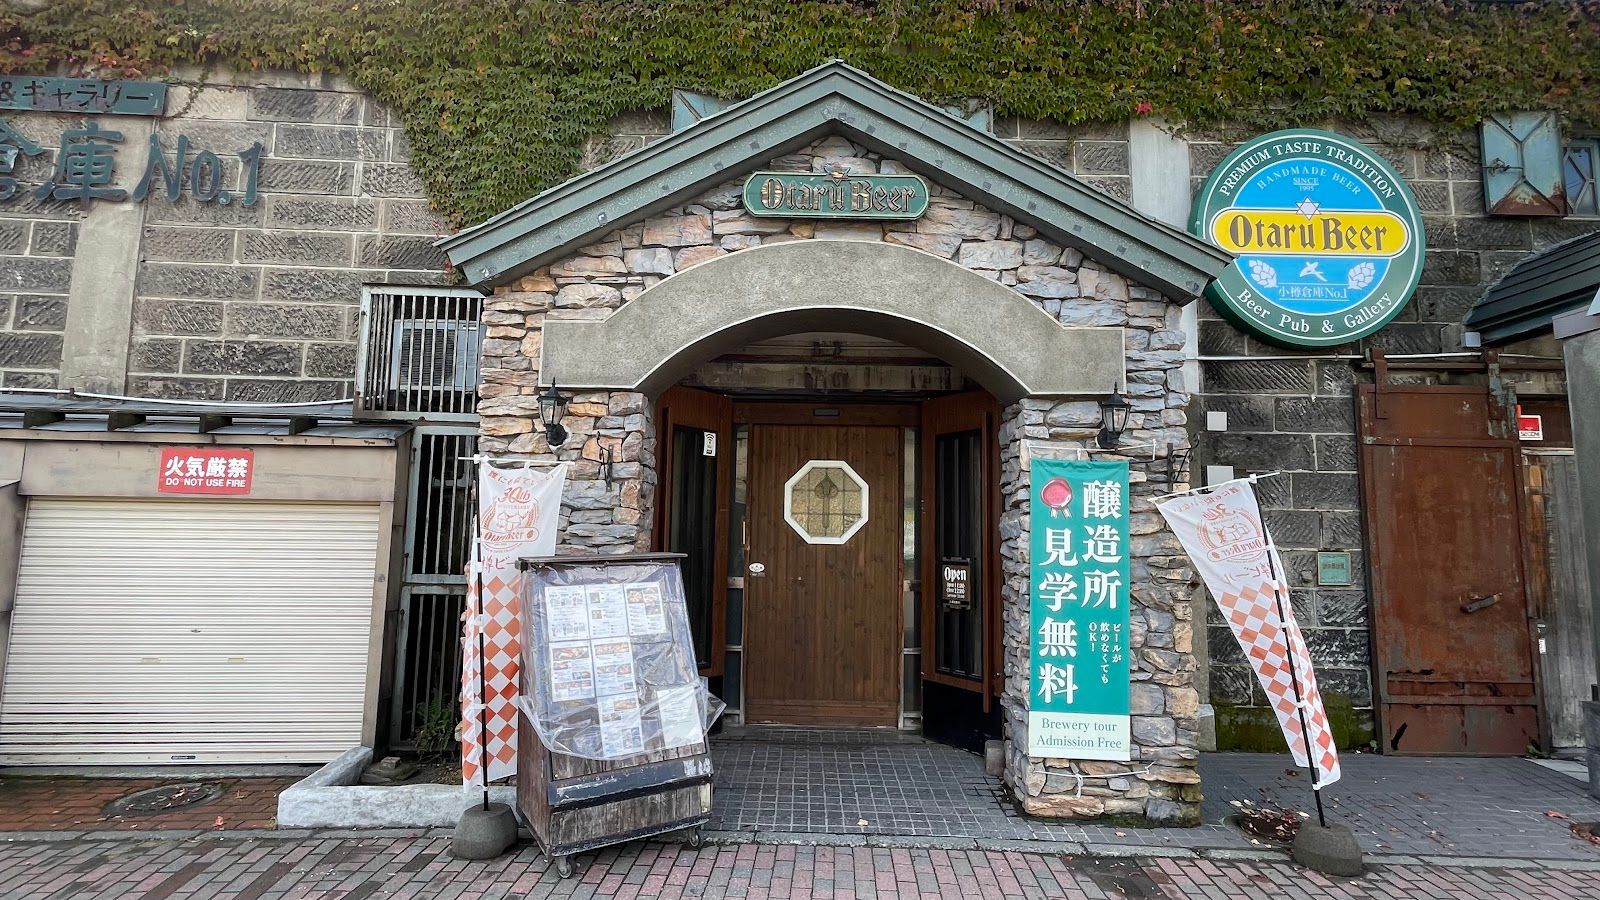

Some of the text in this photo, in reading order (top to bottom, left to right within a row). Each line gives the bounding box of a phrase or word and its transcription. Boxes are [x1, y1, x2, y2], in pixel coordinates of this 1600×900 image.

[1219, 141, 1395, 199] PREMIUM TASTE TRADITION
[1256, 166, 1361, 196] HANDMADE BEER
[1293, 177, 1319, 185] SINCE
[760, 178, 916, 213] Otaru Beer
[1229, 214, 1388, 251] Otaru Beer
[1236, 287, 1393, 334] Beer Pub & Gallery
[165, 456, 248, 477] 火気厳禁
[165, 478, 246, 488] DO NOT USE FIRE
[1082, 479, 1122, 610] 醸造所
[944, 566, 967, 582] Open
[1038, 526, 1079, 705] 見学無料
[1100, 622, 1110, 684] 飲めなくても
[1112, 623, 1122, 663] ビールが
[1036, 735, 1122, 748] Admission Free
[1041, 718, 1118, 733] Brewery tour
